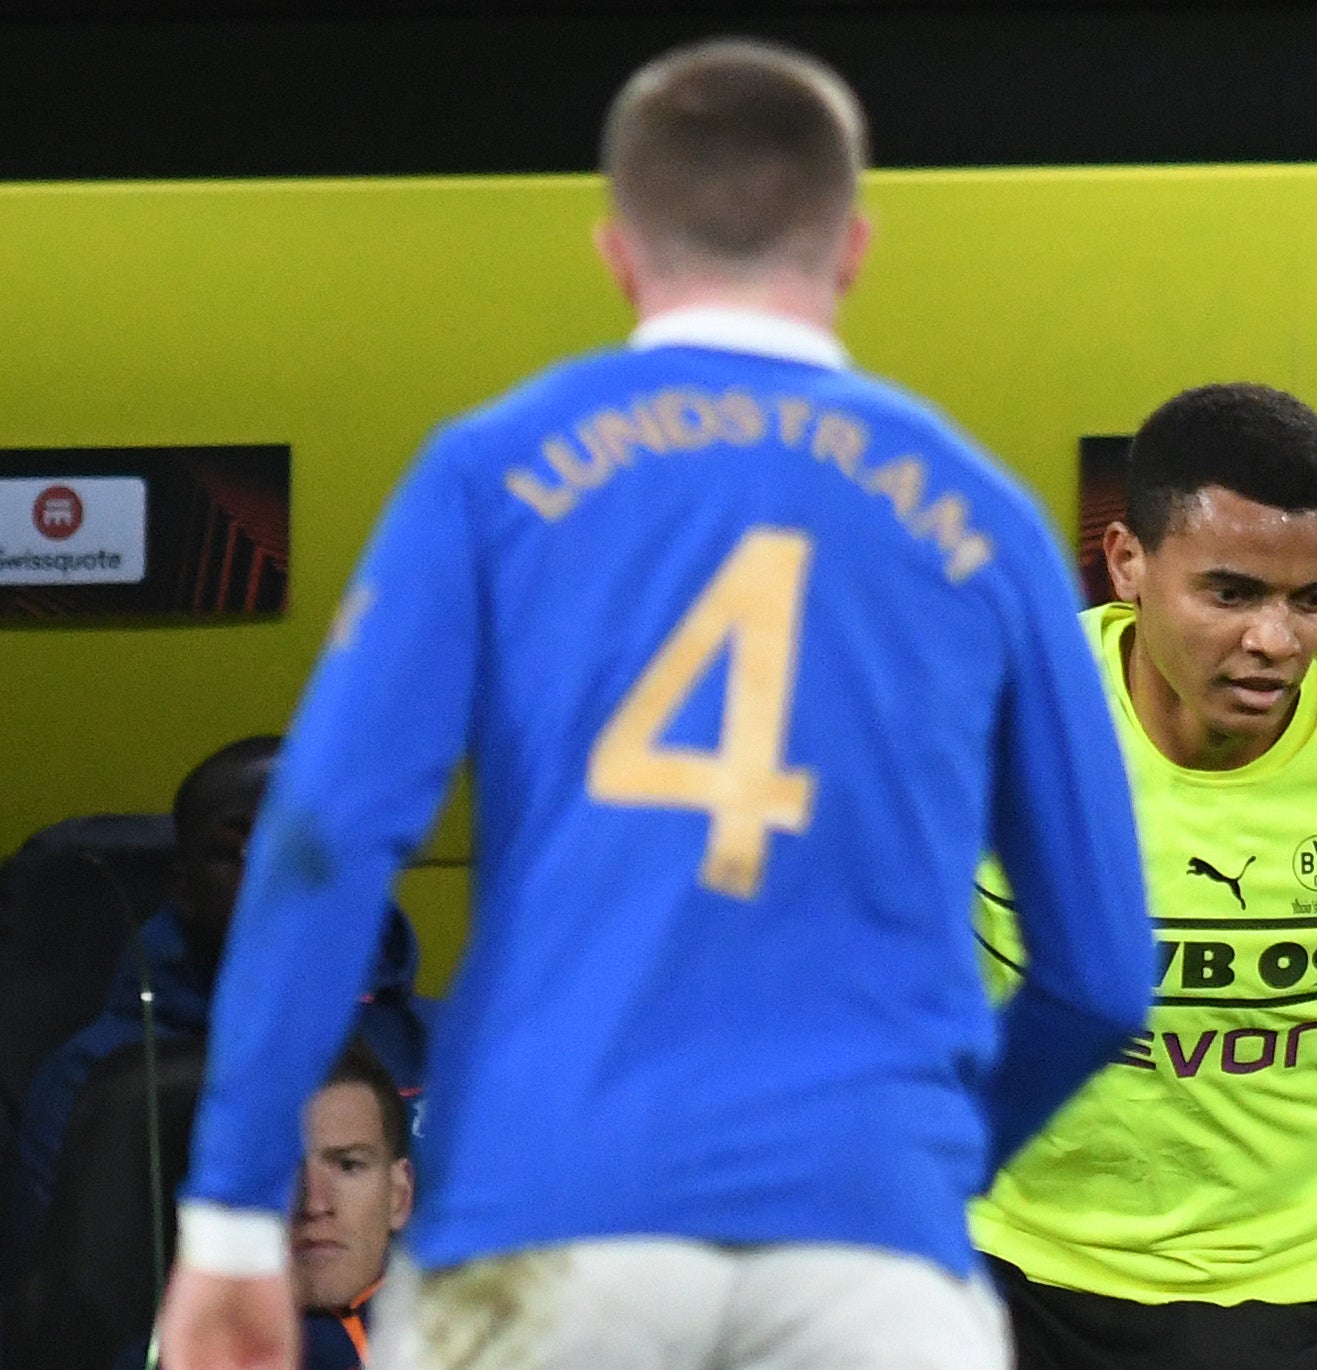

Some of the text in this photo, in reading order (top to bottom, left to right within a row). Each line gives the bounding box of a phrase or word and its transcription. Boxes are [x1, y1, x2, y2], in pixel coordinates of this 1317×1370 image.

[0, 549, 122, 575] wissquote
[503, 388, 994, 584] LUNDSTRAM
[586, 524, 818, 897] 4
